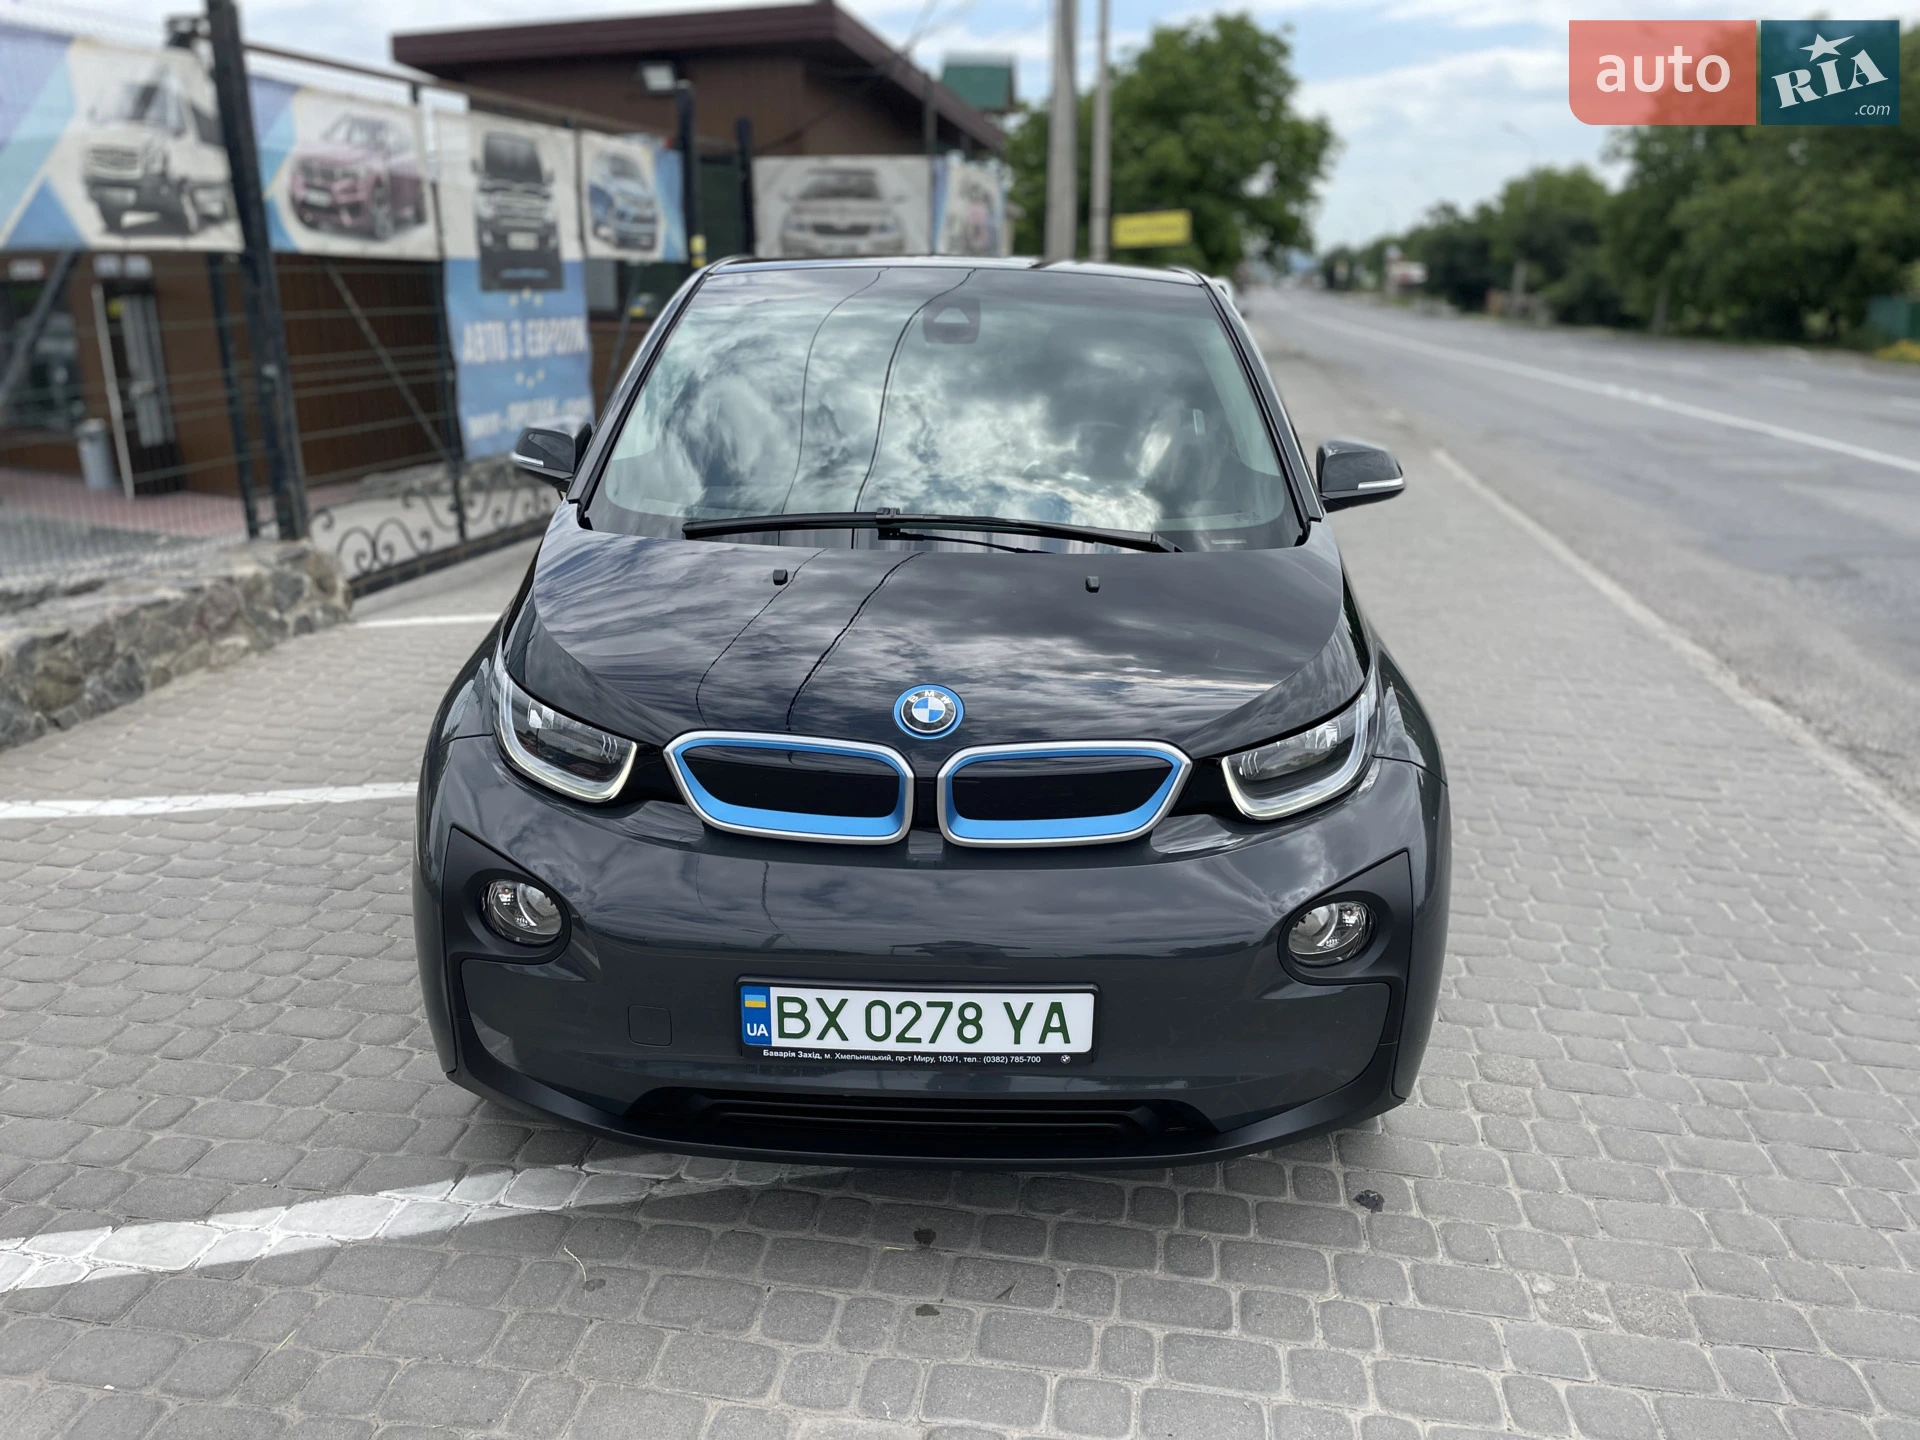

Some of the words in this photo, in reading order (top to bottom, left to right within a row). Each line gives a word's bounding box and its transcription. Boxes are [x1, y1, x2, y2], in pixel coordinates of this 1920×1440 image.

[907, 690, 952, 704] BMW
[776, 995, 849, 1042] BX
[864, 999, 983, 1045] 0278
[1002, 1001, 1071, 1045] YA
[746, 1023, 769, 1037] UA
[762, 1049, 796, 1058] Баварія
[797, 1050, 823, 1060] Захід,
[834, 1052, 894, 1062] Хмельницький,
[895, 1055, 912, 1064] пр-т
[913, 1055, 936, 1064] Миру,
[938, 1055, 962, 1064] 103/1,
[983, 1055, 1009, 1065] (0382)
[1009, 1055, 1042, 1064] 785-700
